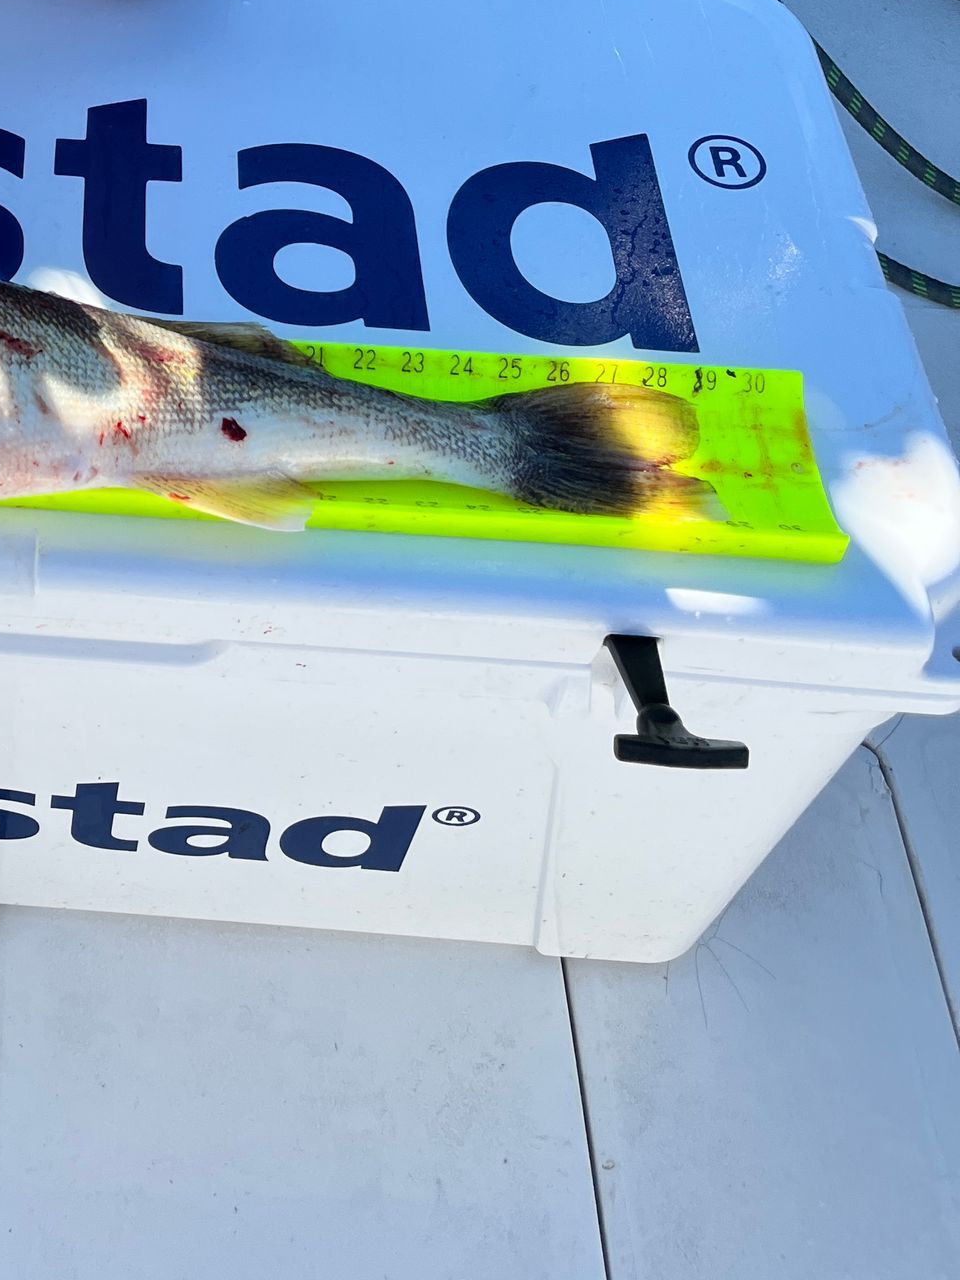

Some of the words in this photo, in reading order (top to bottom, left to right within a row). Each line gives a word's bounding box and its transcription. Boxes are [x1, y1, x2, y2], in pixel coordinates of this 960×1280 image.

[353, 348, 376, 370] 22
[401, 351, 425, 373] 23
[450, 354, 473, 376] 24
[498, 357, 522, 379] 25
[546, 360, 570, 382] 26
[594, 363, 619, 383] 27
[643, 366, 667, 387] 28
[742, 371, 765, 393] 30
